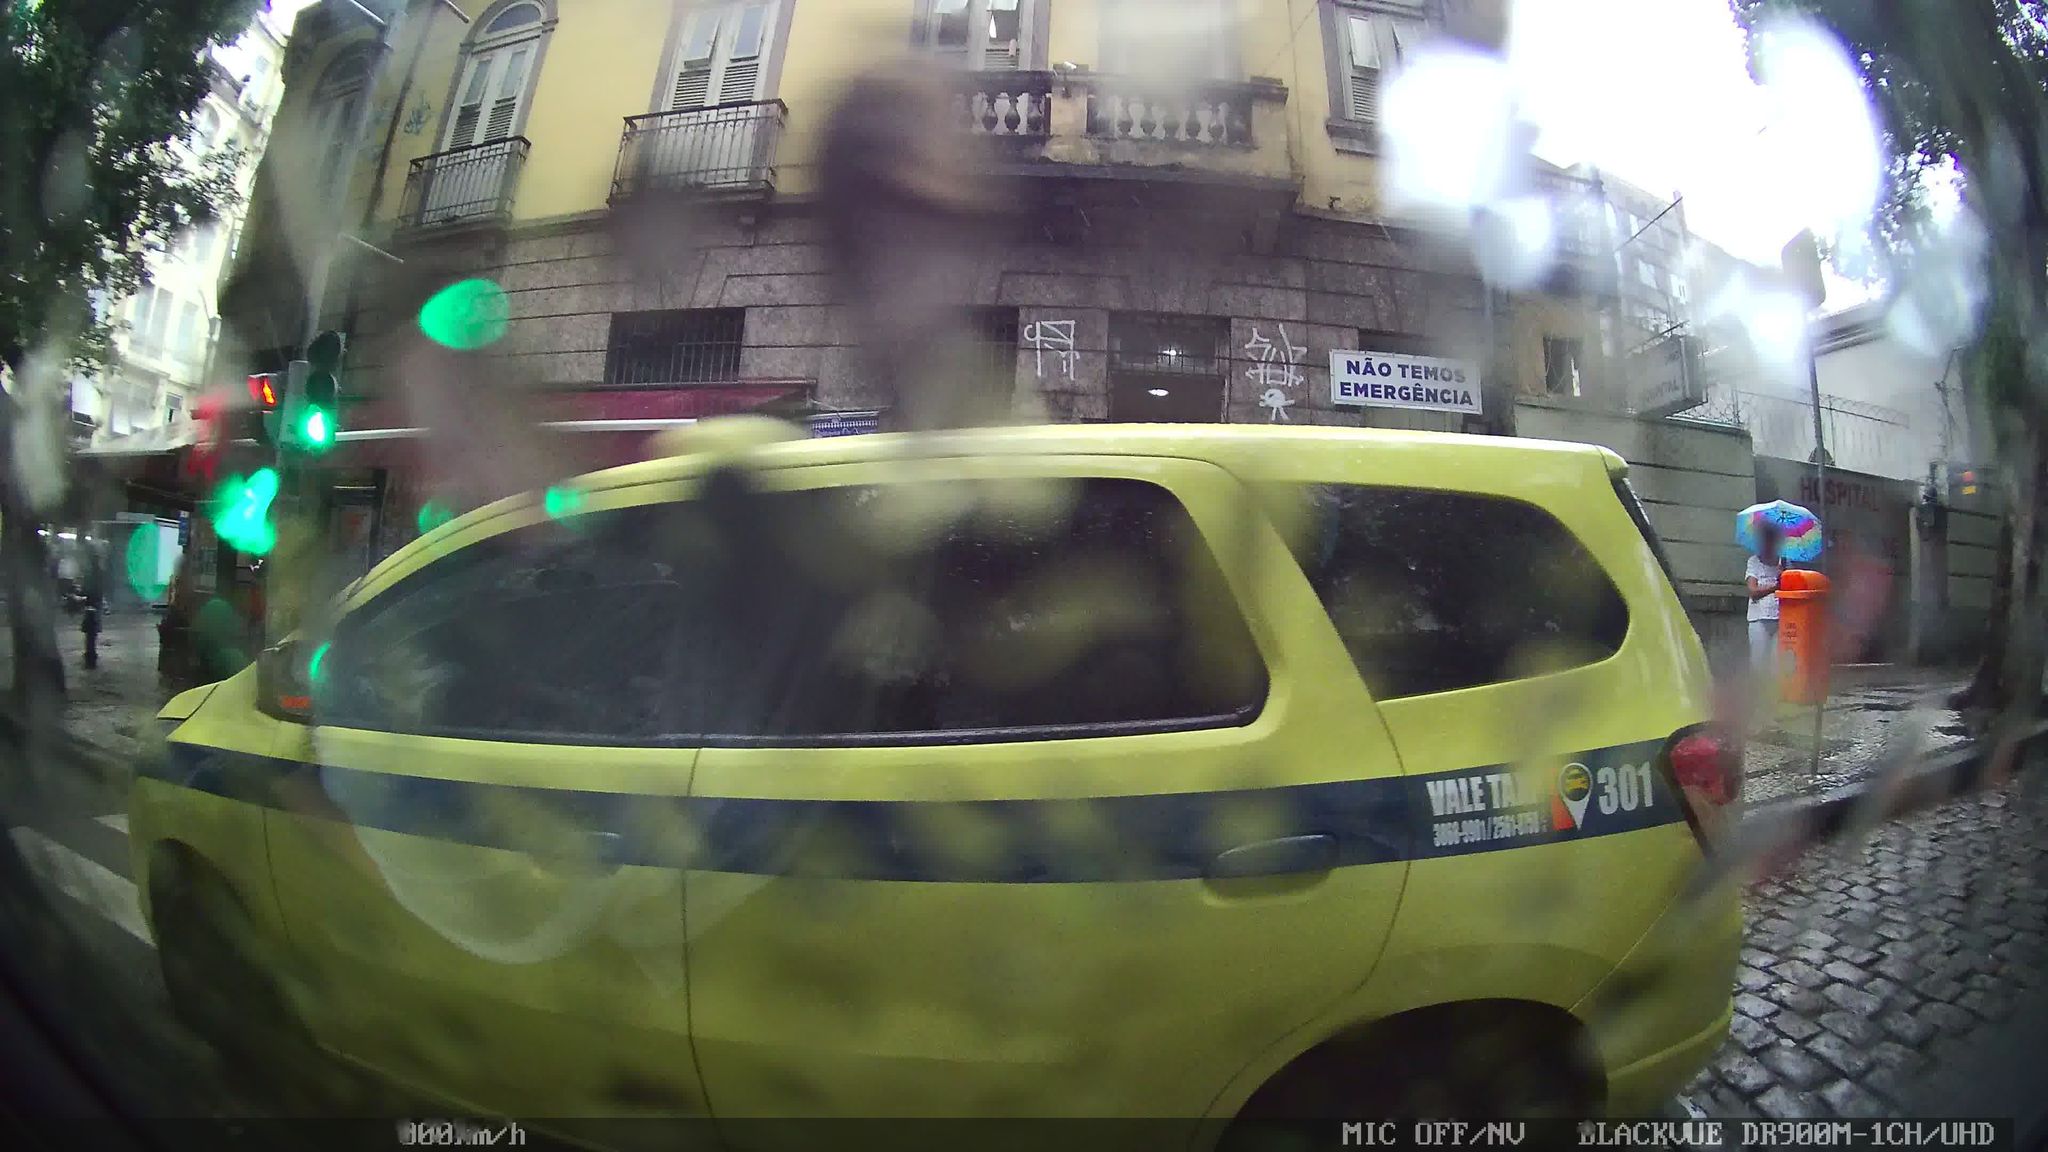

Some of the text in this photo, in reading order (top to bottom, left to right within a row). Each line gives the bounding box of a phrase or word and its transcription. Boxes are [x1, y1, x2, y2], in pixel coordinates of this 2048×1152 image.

[1346, 357, 1466, 384] NÃO TEMOS
[1339, 381, 1474, 406] EMERGÊNCIA
[1425, 772, 1536, 816] VALE TA
[1597, 760, 1653, 815] 301
